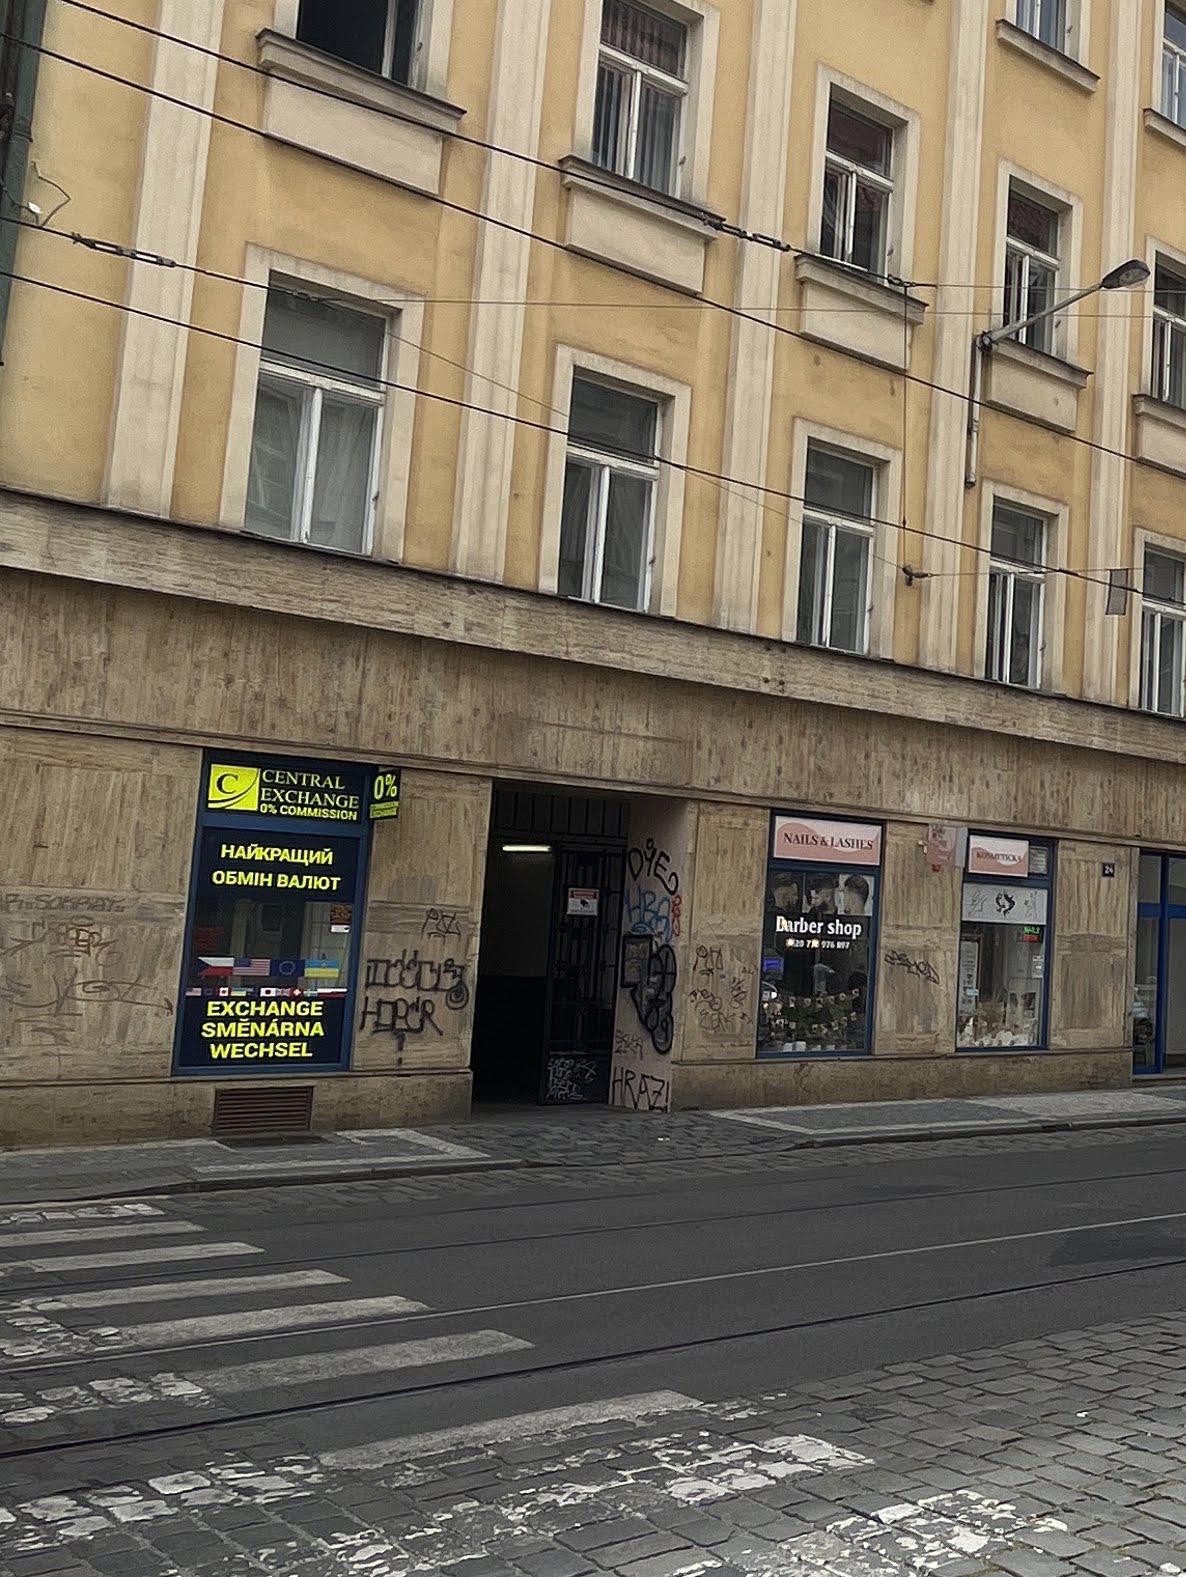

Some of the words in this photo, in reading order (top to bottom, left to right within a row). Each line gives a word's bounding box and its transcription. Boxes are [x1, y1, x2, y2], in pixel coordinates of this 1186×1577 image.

[216, 773, 239, 794] C
[262, 769, 346, 790] CENTRAL
[373, 773, 398, 800] 0%
[260, 787, 360, 809] EXCHANGE
[259, 803, 278, 815] 0%
[279, 804, 358, 821] COMMISSION
[783, 832, 818, 846] NAILS
[820, 835, 828, 847] &
[830, 836, 874, 850] LASHES
[220, 843, 334, 867] НАЙКРАЩИЙ
[212, 870, 273, 887] ОБМІН
[276, 873, 341, 890] ВАЛЮТ
[775, 915, 824, 934] Barber
[827, 918, 862, 940] shop
[206, 1001, 325, 1017] EXCHANGE
[201, 1018, 325, 1038] SMĚNÁRNA
[209, 1042, 314, 1059] WECHSEL
